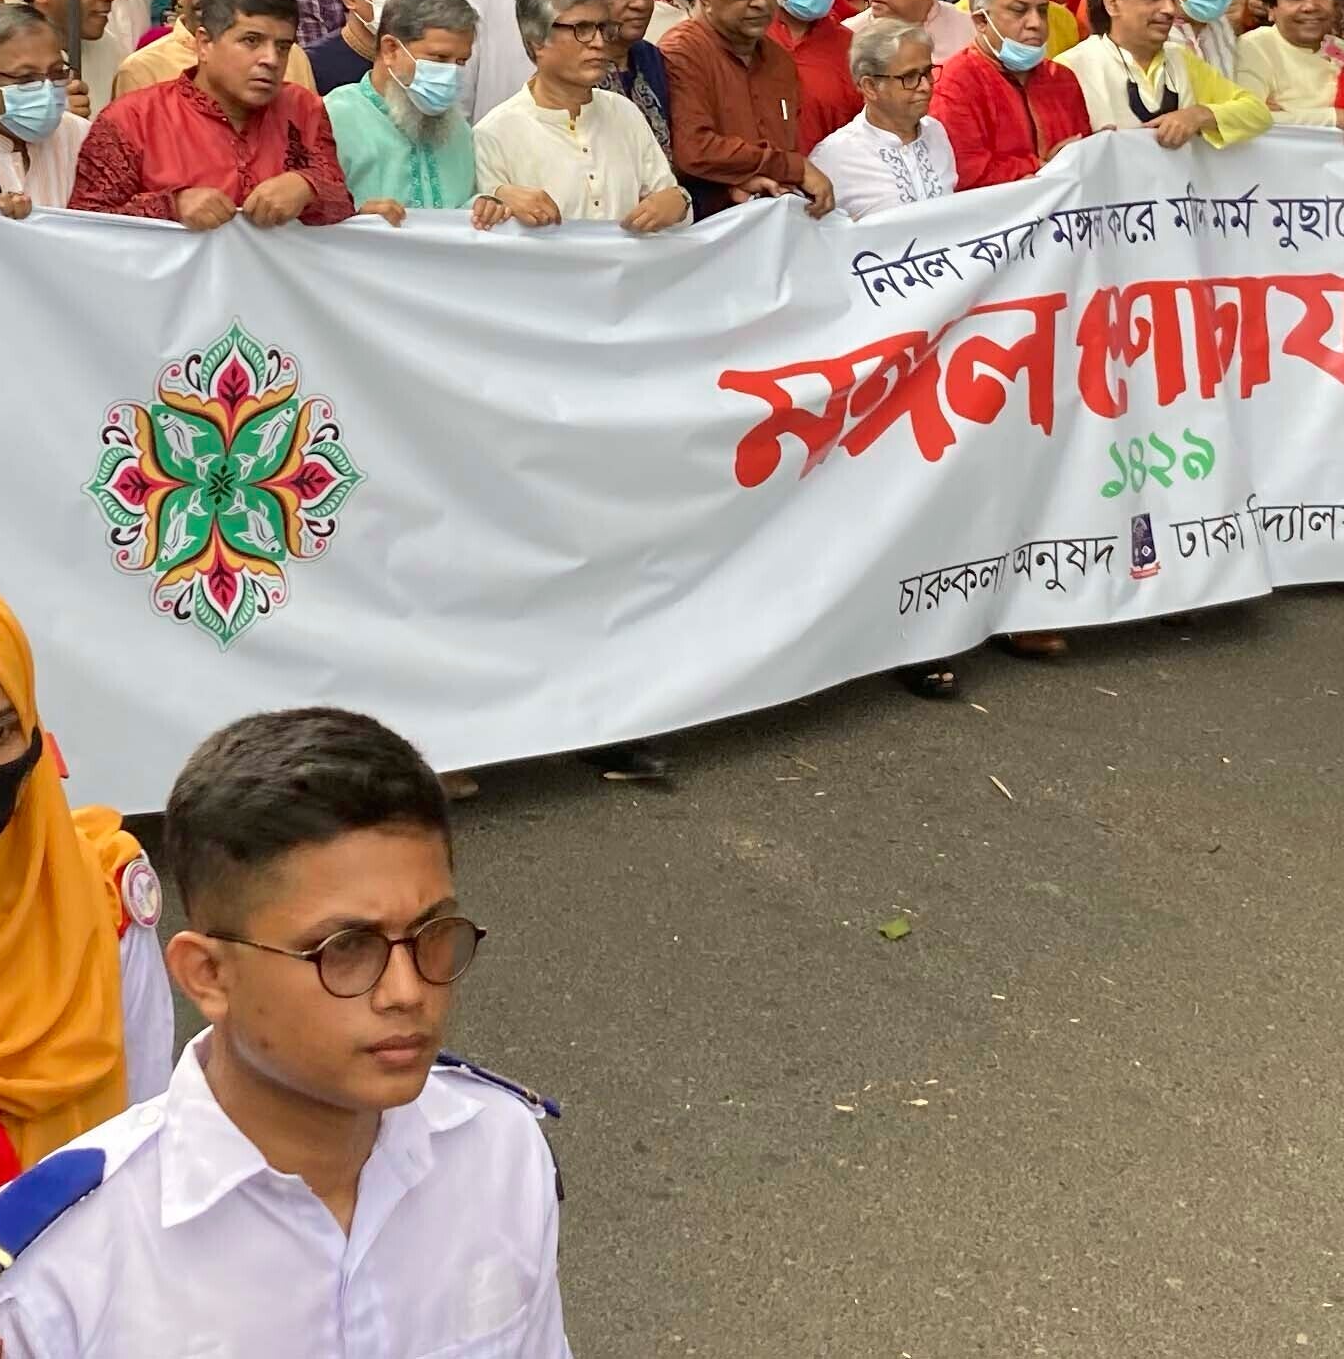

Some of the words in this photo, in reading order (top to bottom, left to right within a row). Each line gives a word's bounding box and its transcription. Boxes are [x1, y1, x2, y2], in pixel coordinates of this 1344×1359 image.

[851, 238, 964, 306] নির্মল
[1210, 183, 1260, 240] মর্ম
[718, 293, 1068, 488] মঙ্গল
[1100, 427, 1216, 499] ১৪২৯
[898, 551, 1010, 615] চারুকলা
[1011, 535, 1119, 593] অনুষদ
[1169, 511, 1245, 559] ঢাকা
